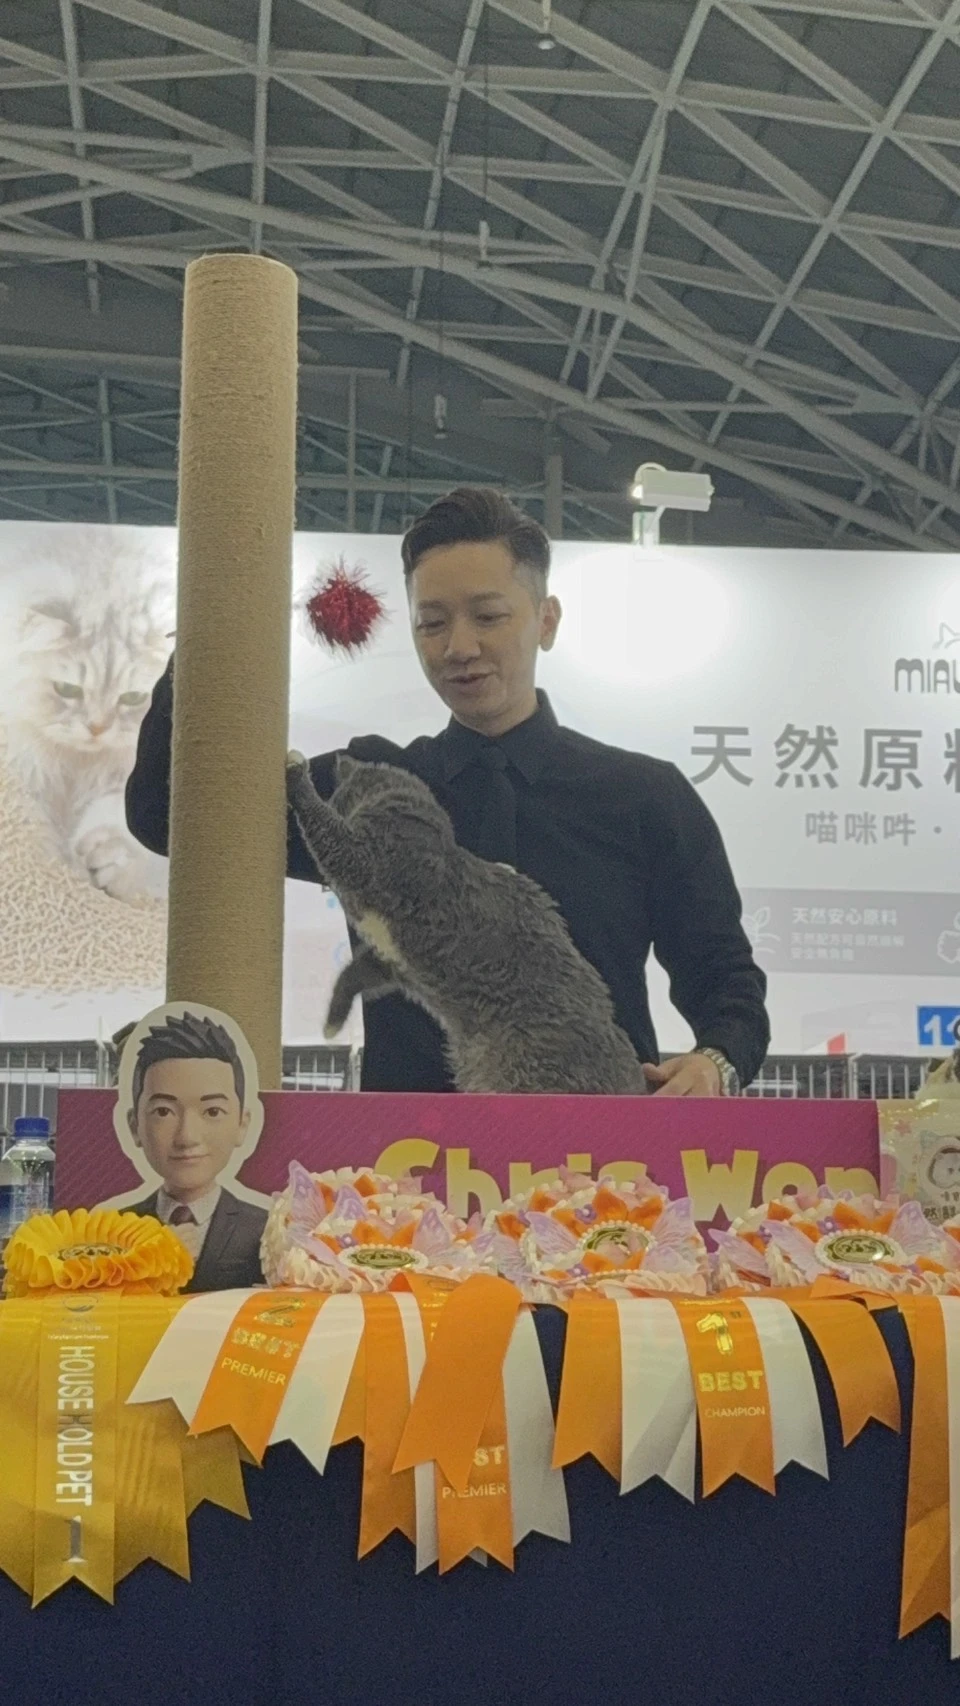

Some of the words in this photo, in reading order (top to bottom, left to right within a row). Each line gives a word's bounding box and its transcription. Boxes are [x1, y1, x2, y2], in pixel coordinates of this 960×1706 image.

[690, 723, 960, 793] 天然原
[221, 1357, 287, 1386] PREMIER
[697, 1370, 763, 1392] BEST
[704, 1406, 766, 1418] CHAMPION
[55, 1470, 93, 1506] PET
